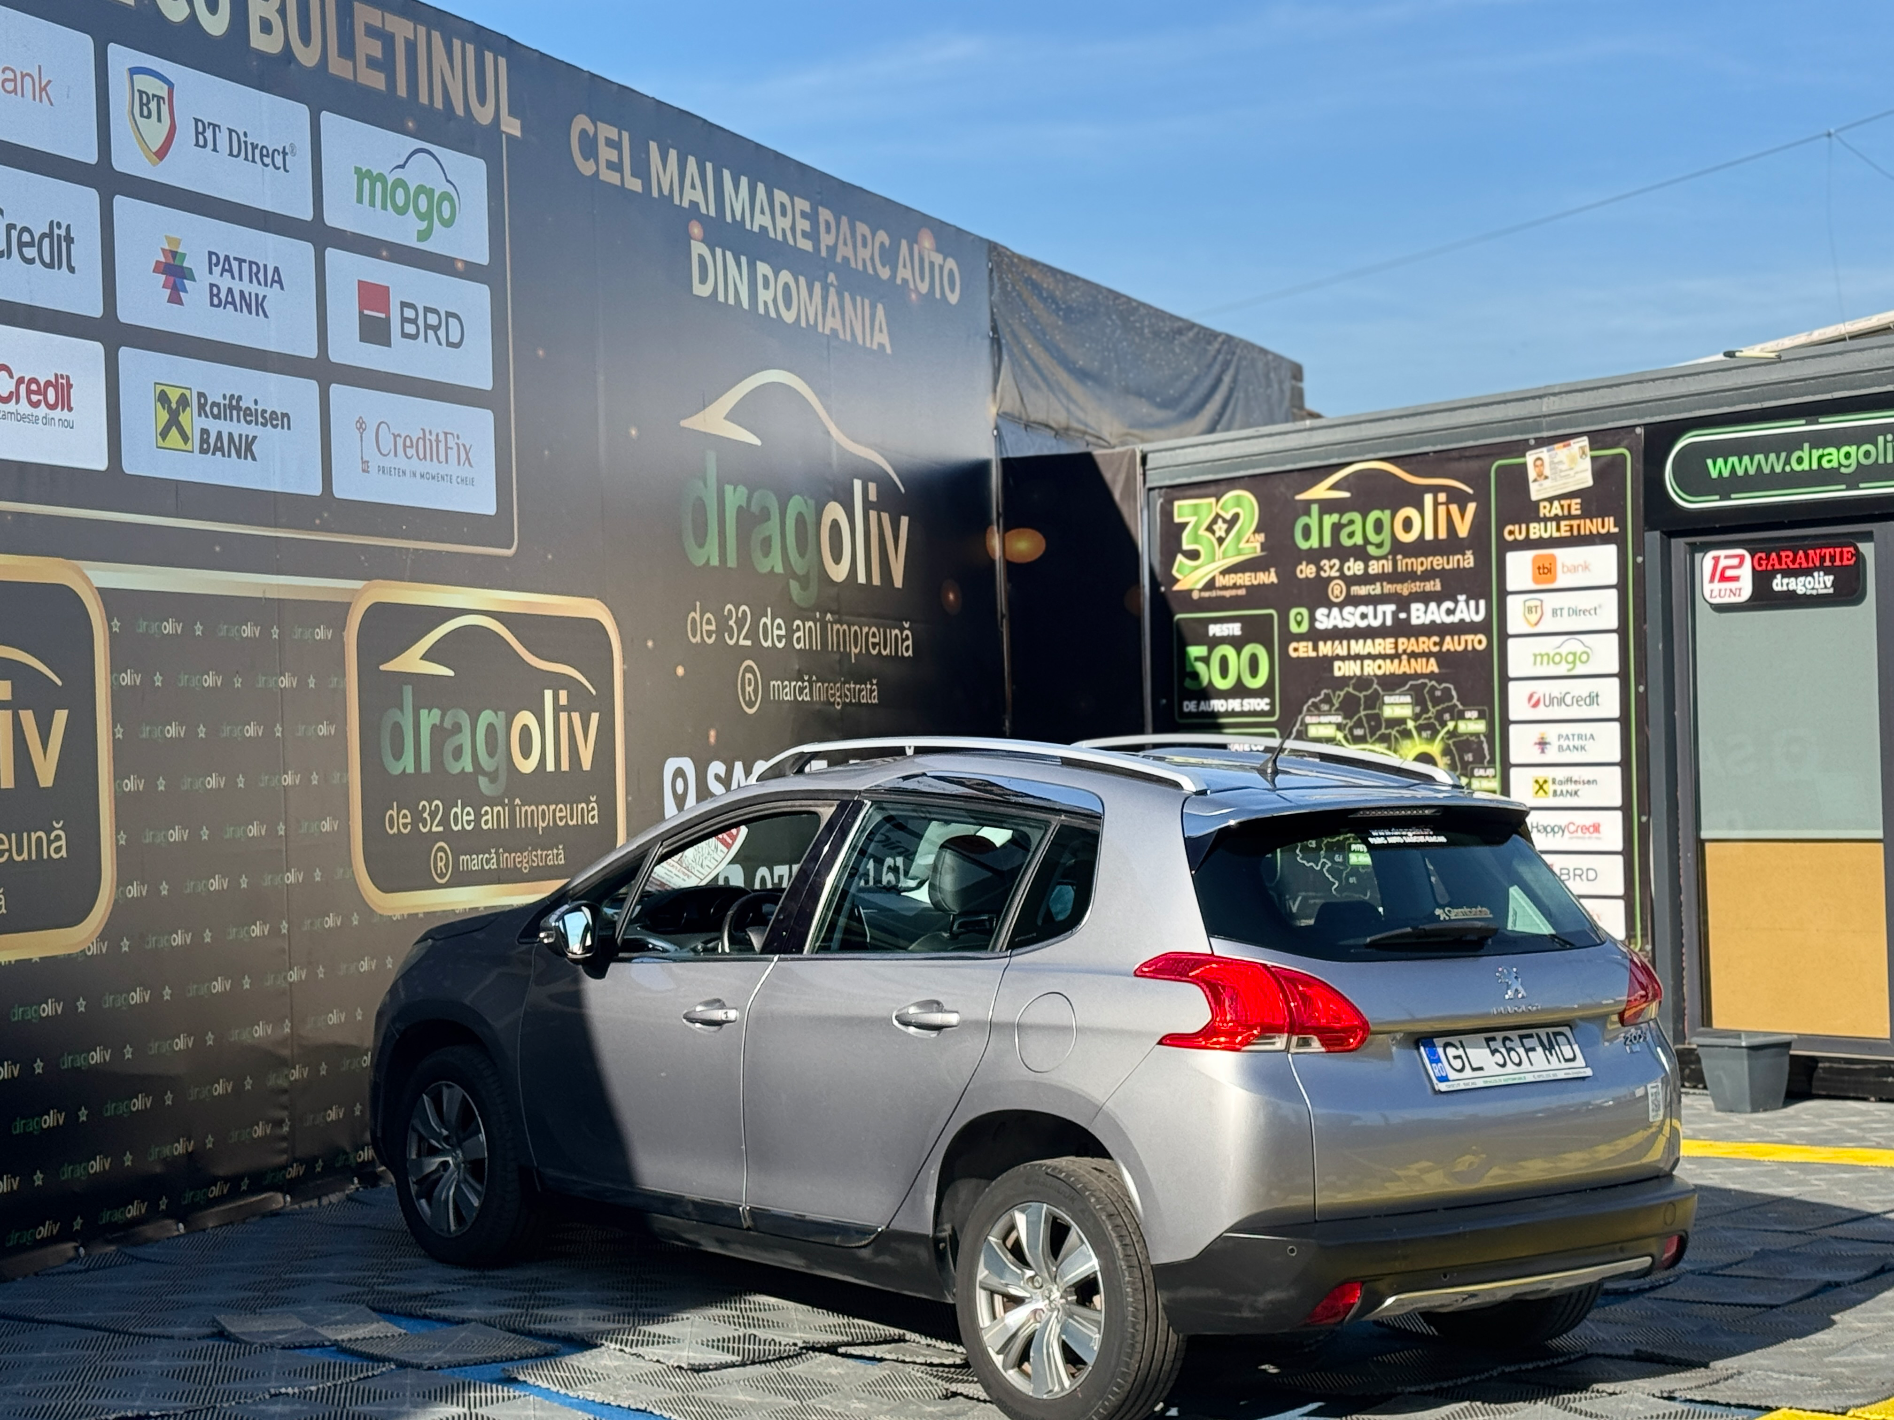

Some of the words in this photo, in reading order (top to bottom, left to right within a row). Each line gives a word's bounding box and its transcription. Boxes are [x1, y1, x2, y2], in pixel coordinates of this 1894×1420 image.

[1, 65, 54, 107] ank
[137, 88, 165, 124] BT
[193, 117, 221, 154] BT
[354, 165, 457, 242] mogo
[570, 113, 643, 193] CEL
[649, 140, 716, 218] MAI
[722, 168, 813, 252] MARE
[818, 206, 891, 281] PARC
[896, 238, 961, 306] AUTO
[0, 207, 75, 274] redit
[208, 251, 285, 291] PATRIA
[209, 283, 269, 319] BANK
[690, 240, 749, 310] DIN
[756, 258, 892, 354] ROMÂNIA
[400, 301, 465, 349] BRD
[42, 413, 56, 427] din
[58, 418, 74, 429] nou
[197, 392, 291, 431] Raiffeisen
[199, 428, 257, 462] BANK
[375, 421, 474, 468] CreditFix
[1706, 433, 1894, 479] www.dragoli
[377, 465, 406, 477] PRIETEN
[409, 470, 417, 478] IN
[420, 471, 453, 484] MOMENTE
[455, 475, 475, 486] CHEIE
[1294, 492, 1477, 556] dragoliv
[1539, 499, 1581, 518] RATE
[681, 449, 909, 608] dragoliv
[1172, 489, 1260, 580] 32
[1503, 524, 1526, 541] CU
[1529, 517, 1619, 539] BULETINUL
[1296, 561, 1316, 579] de
[1320, 560, 1340, 578] 32
[1344, 558, 1364, 576] de
[1368, 555, 1393, 574] ani
[1397, 550, 1474, 575] împreună
[1537, 563, 1552, 576] tbi
[1562, 561, 1591, 574] bank
[1709, 554, 1745, 584] 12
[1753, 546, 1857, 571] GARANTIE
[1351, 582, 1381, 597] marcă
[1383, 579, 1442, 597] înregistrată
[1709, 587, 1743, 599] LUNI
[1772, 571, 1834, 595] dragoliv
[1315, 604, 1396, 630] SASCUT
[1411, 595, 1486, 625] BACĂU
[1527, 605, 1539, 615] BT
[1552, 607, 1565, 618] BT
[687, 601, 716, 645] de
[724, 604, 752, 646] 32
[759, 607, 786, 649] de
[793, 612, 821, 651] ani
[826, 614, 914, 663] împreună
[1208, 623, 1242, 637] PESTE
[1288, 641, 1318, 658] CEL
[1322, 639, 1348, 656] MAI
[1354, 637, 1395, 655] MARE
[1398, 635, 1440, 653] PARC
[1443, 634, 1487, 651] AUTO
[1184, 643, 1270, 690] 500
[1334, 660, 1361, 677] DIN
[1363, 654, 1438, 676] ROMÂNIA
[1533, 650, 1591, 672] mogo
[770, 675, 811, 702] marcă
[812, 675, 879, 710] înregistrată
[1183, 700, 1198, 712] DE
[1199, 699, 1227, 712] AUTO
[1227, 698, 1241, 711] PE
[1242, 698, 1271, 711] STOC
[1543, 691, 1600, 708] UniCredit
[0, 680, 69, 789] iv
[380, 685, 600, 797] dragoliv
[1557, 733, 1596, 742] PATRIA
[1557, 744, 1587, 753] BANK
[1552, 777, 1598, 786] Raiffeisen
[1552, 789, 1580, 798] BANK
[385, 802, 412, 835] de
[419, 799, 444, 833] 32
[450, 799, 475, 832] de
[481, 798, 510, 830] ani
[514, 794, 599, 835] împreună
[1530, 821, 1601, 838] HappyCredit
[459, 848, 497, 873] marcă
[499, 844, 566, 873] înregistrată
[1559, 868, 1598, 882] BRD
[10, 999, 63, 1023] dragoliv
[60, 1047, 111, 1069] dragoliv
[148, 1034, 194, 1056] dragoliv
[1442, 1040, 1484, 1073] GL
[1433, 1063, 1447, 1077] RO
[11, 1110, 65, 1134] dragoliv
[103, 1094, 152, 1117] dragoliv
[187, 1078, 233, 1101] dragoliv
[60, 1155, 111, 1180] dragoliv
[148, 1138, 194, 1162] dragoliv
[6, 1220, 60, 1247] dragoliv
[98, 1199, 147, 1224] dragoliv
[181, 1179, 230, 1205] dragoliv
